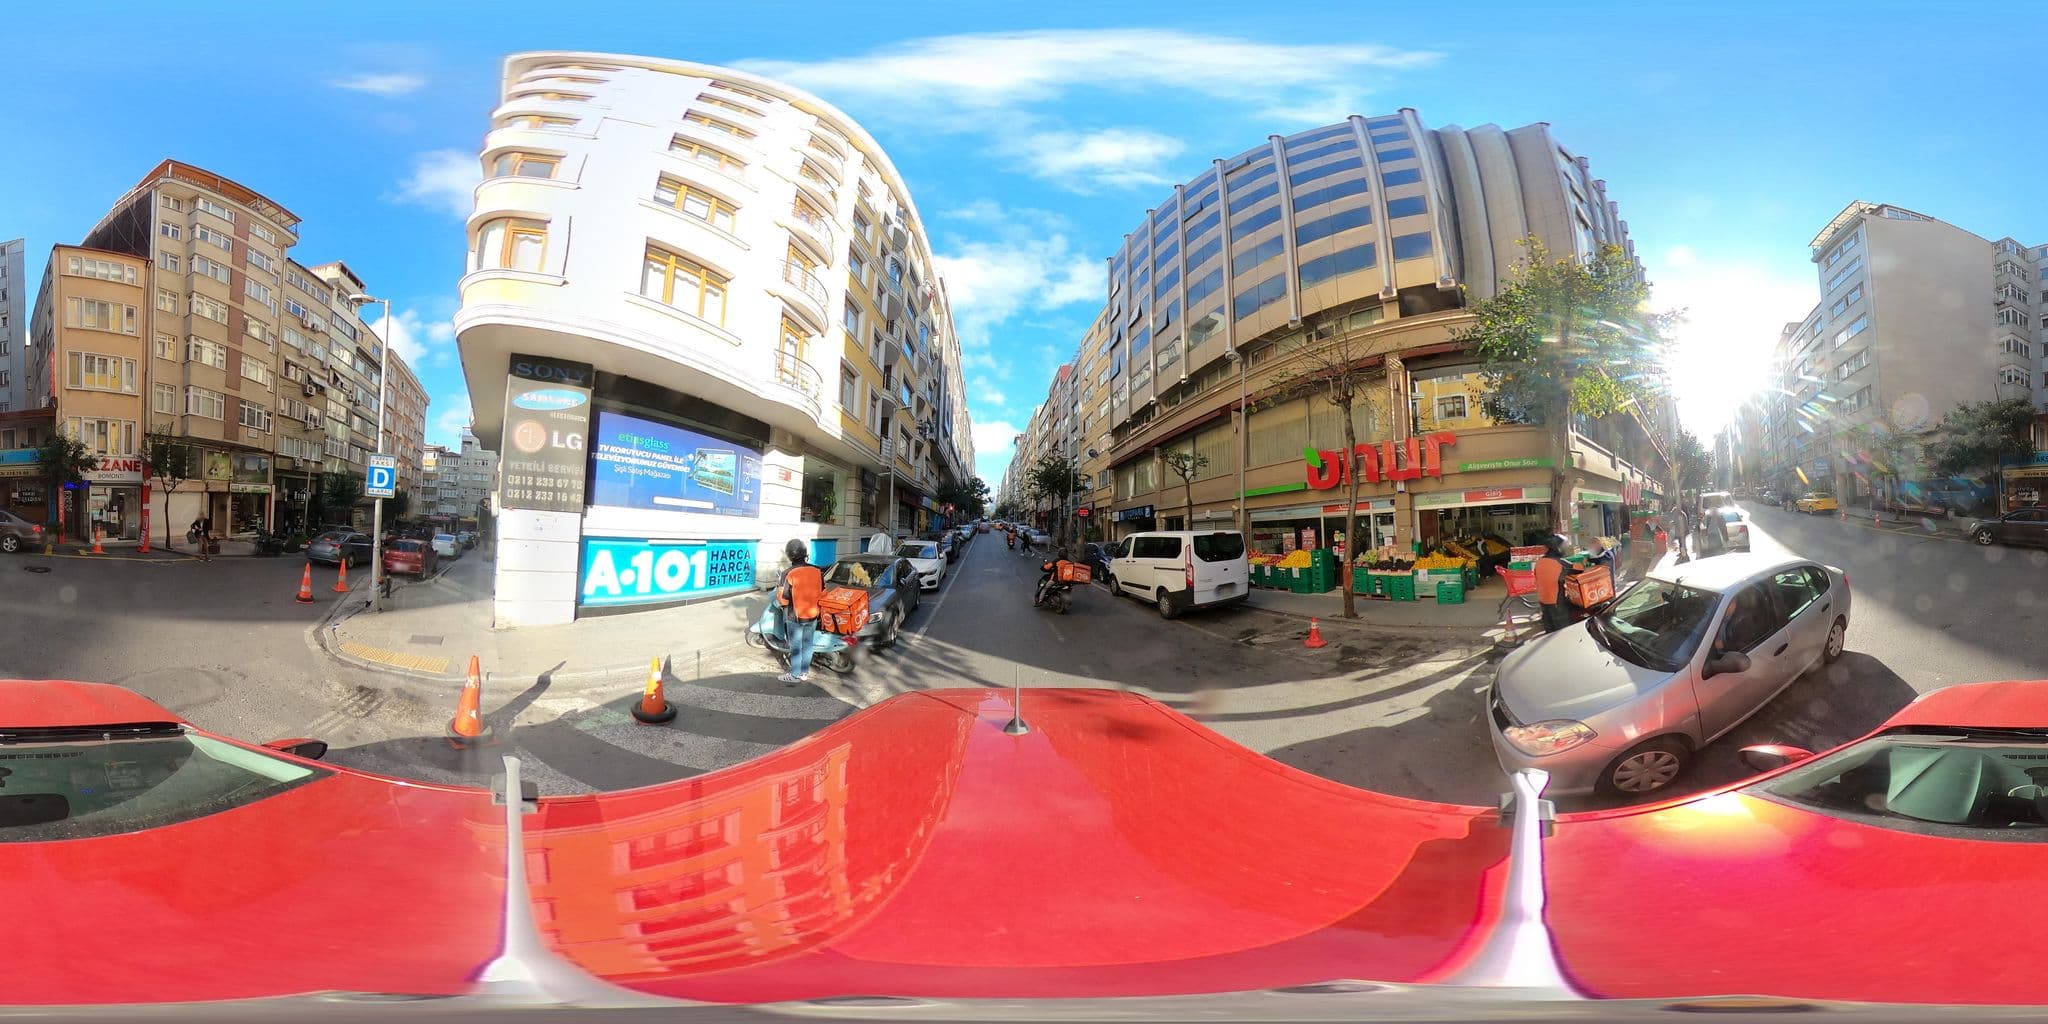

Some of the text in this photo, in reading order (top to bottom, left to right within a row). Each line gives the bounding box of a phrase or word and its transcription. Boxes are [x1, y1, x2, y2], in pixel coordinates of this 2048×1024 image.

[515, 362, 586, 383] SONY
[552, 431, 583, 450] LG
[599, 444, 610, 452] TV
[373, 468, 389, 487] D
[507, 475, 533, 486] 0212
[536, 477, 555, 487] 233
[507, 489, 533, 500] 0212
[535, 491, 554, 501] 233
[711, 549, 751, 561] HARCA
[710, 561, 750, 574] HARCA
